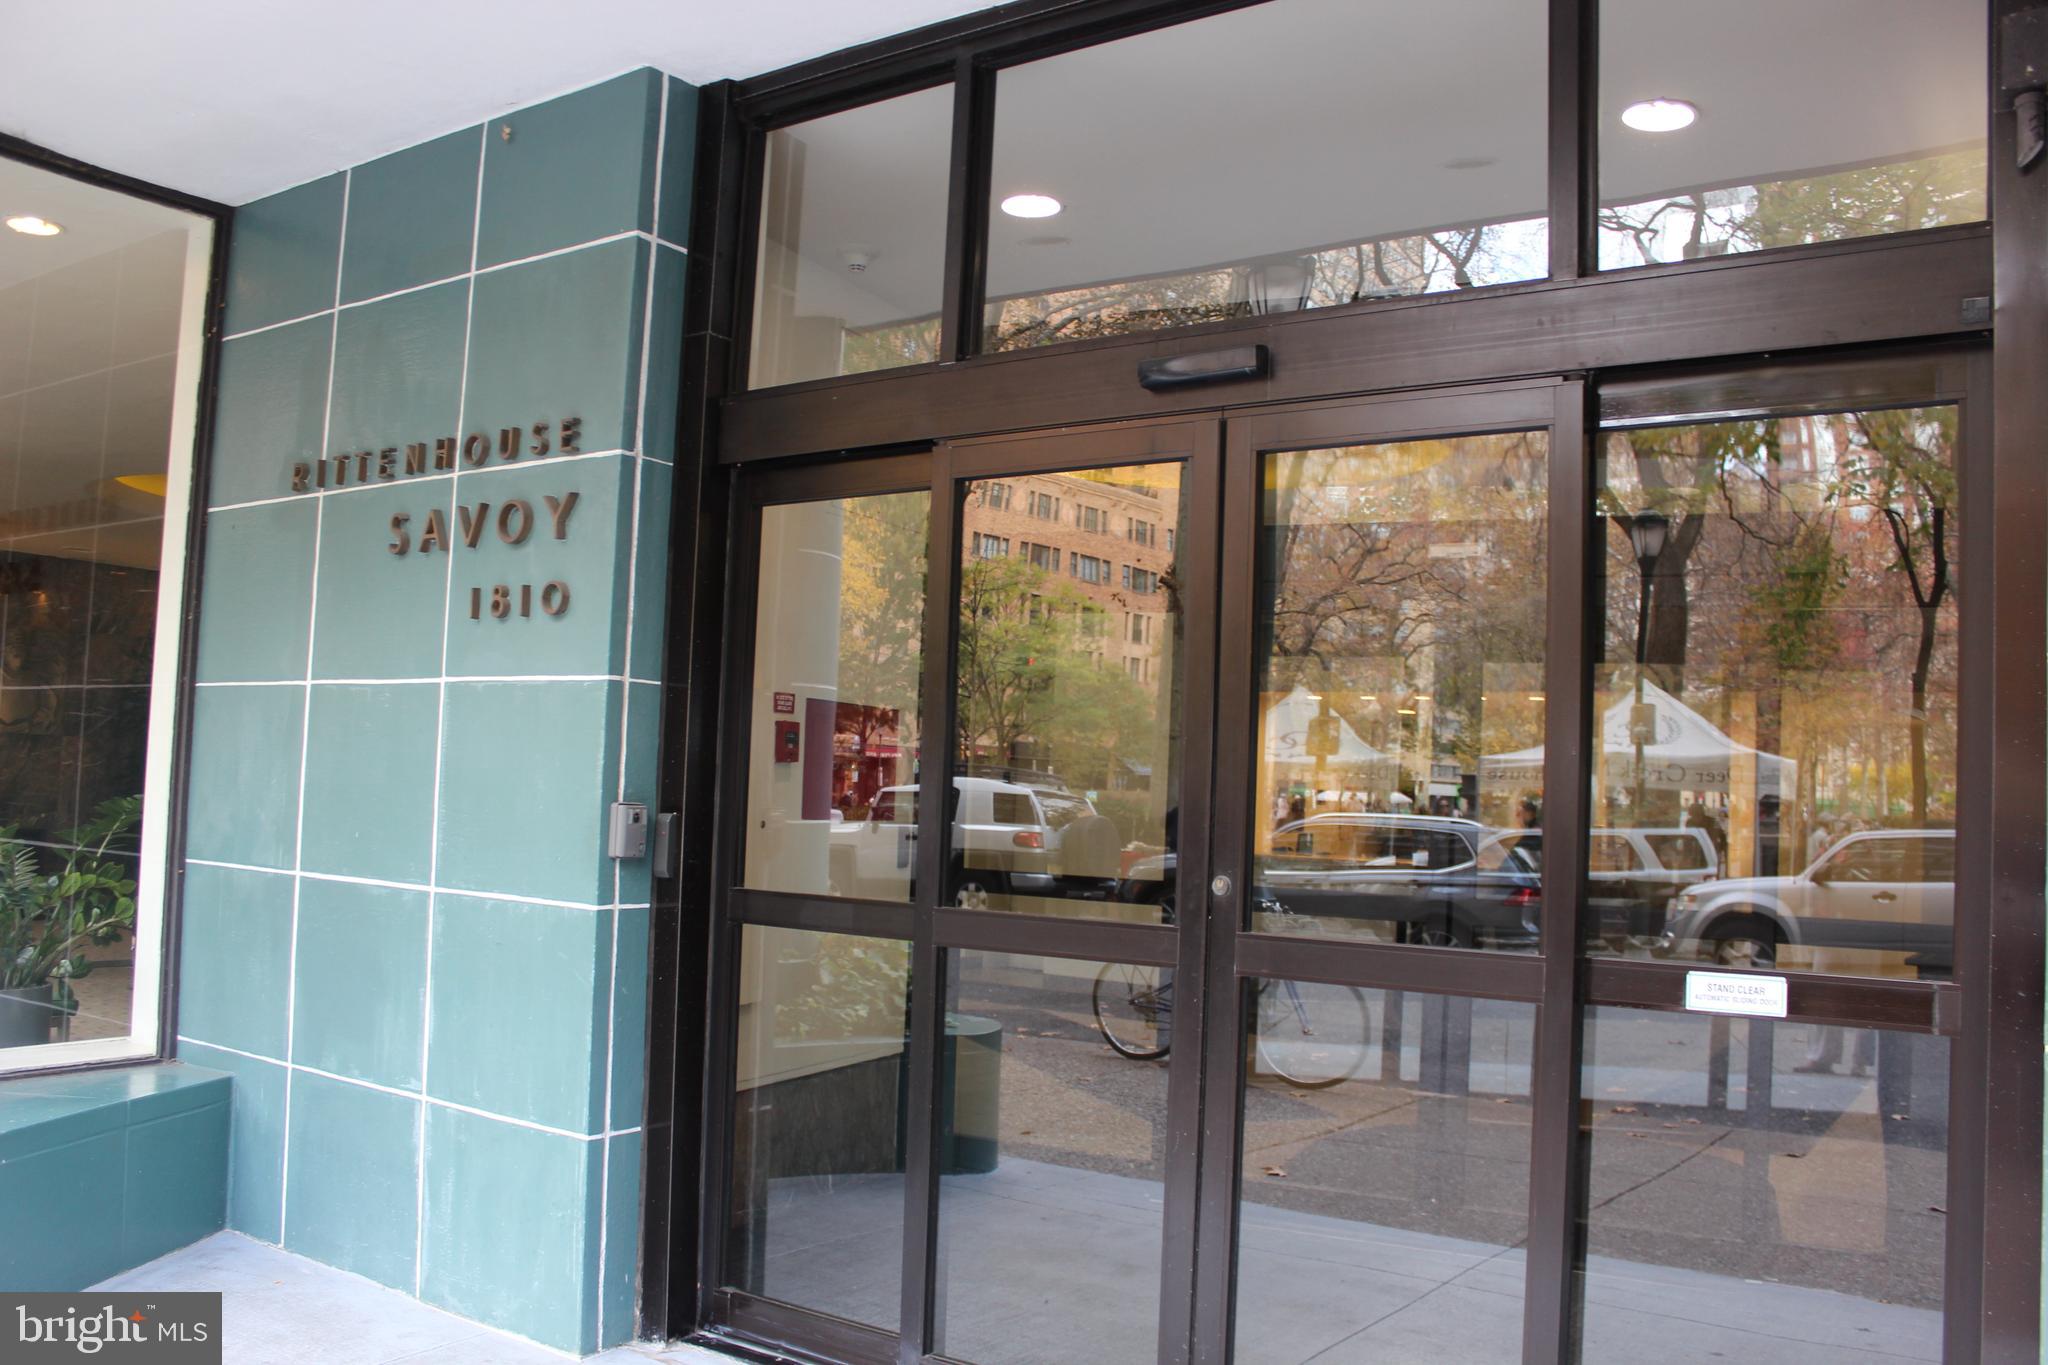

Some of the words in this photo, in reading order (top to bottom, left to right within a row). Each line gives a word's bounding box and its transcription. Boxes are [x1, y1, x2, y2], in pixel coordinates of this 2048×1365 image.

[291, 417, 582, 492] RITTENHOUSE
[388, 492, 580, 555] SAVOY
[470, 580, 571, 620] 1810
[1706, 983, 1735, 993] STAND
[1737, 985, 1766, 996] CLEAR
